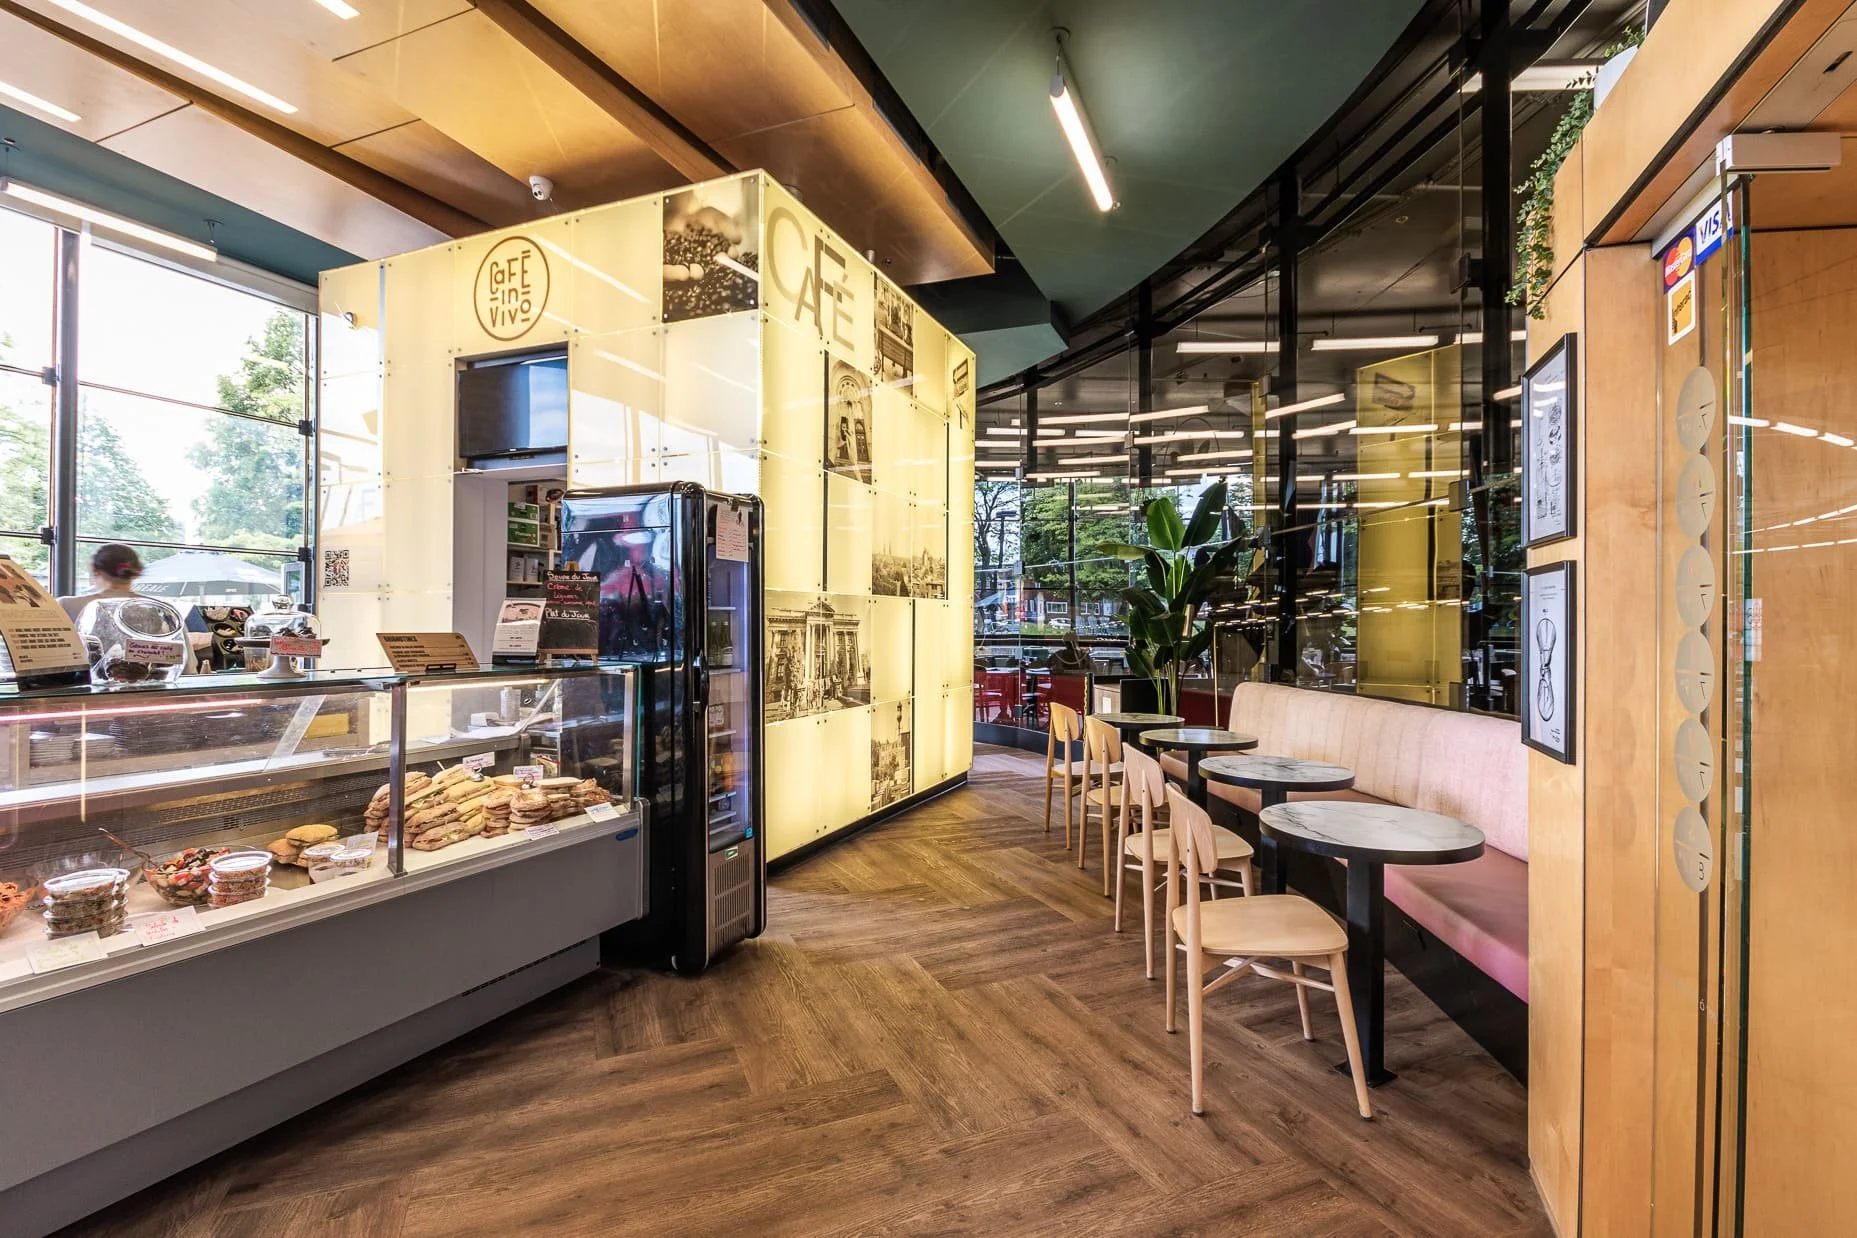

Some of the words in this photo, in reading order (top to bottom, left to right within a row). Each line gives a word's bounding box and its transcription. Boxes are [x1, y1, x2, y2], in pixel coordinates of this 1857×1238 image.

[767, 207, 854, 351] CAFÉ
[502, 288, 518, 304] in
[545, 608, 558, 617] Plat
